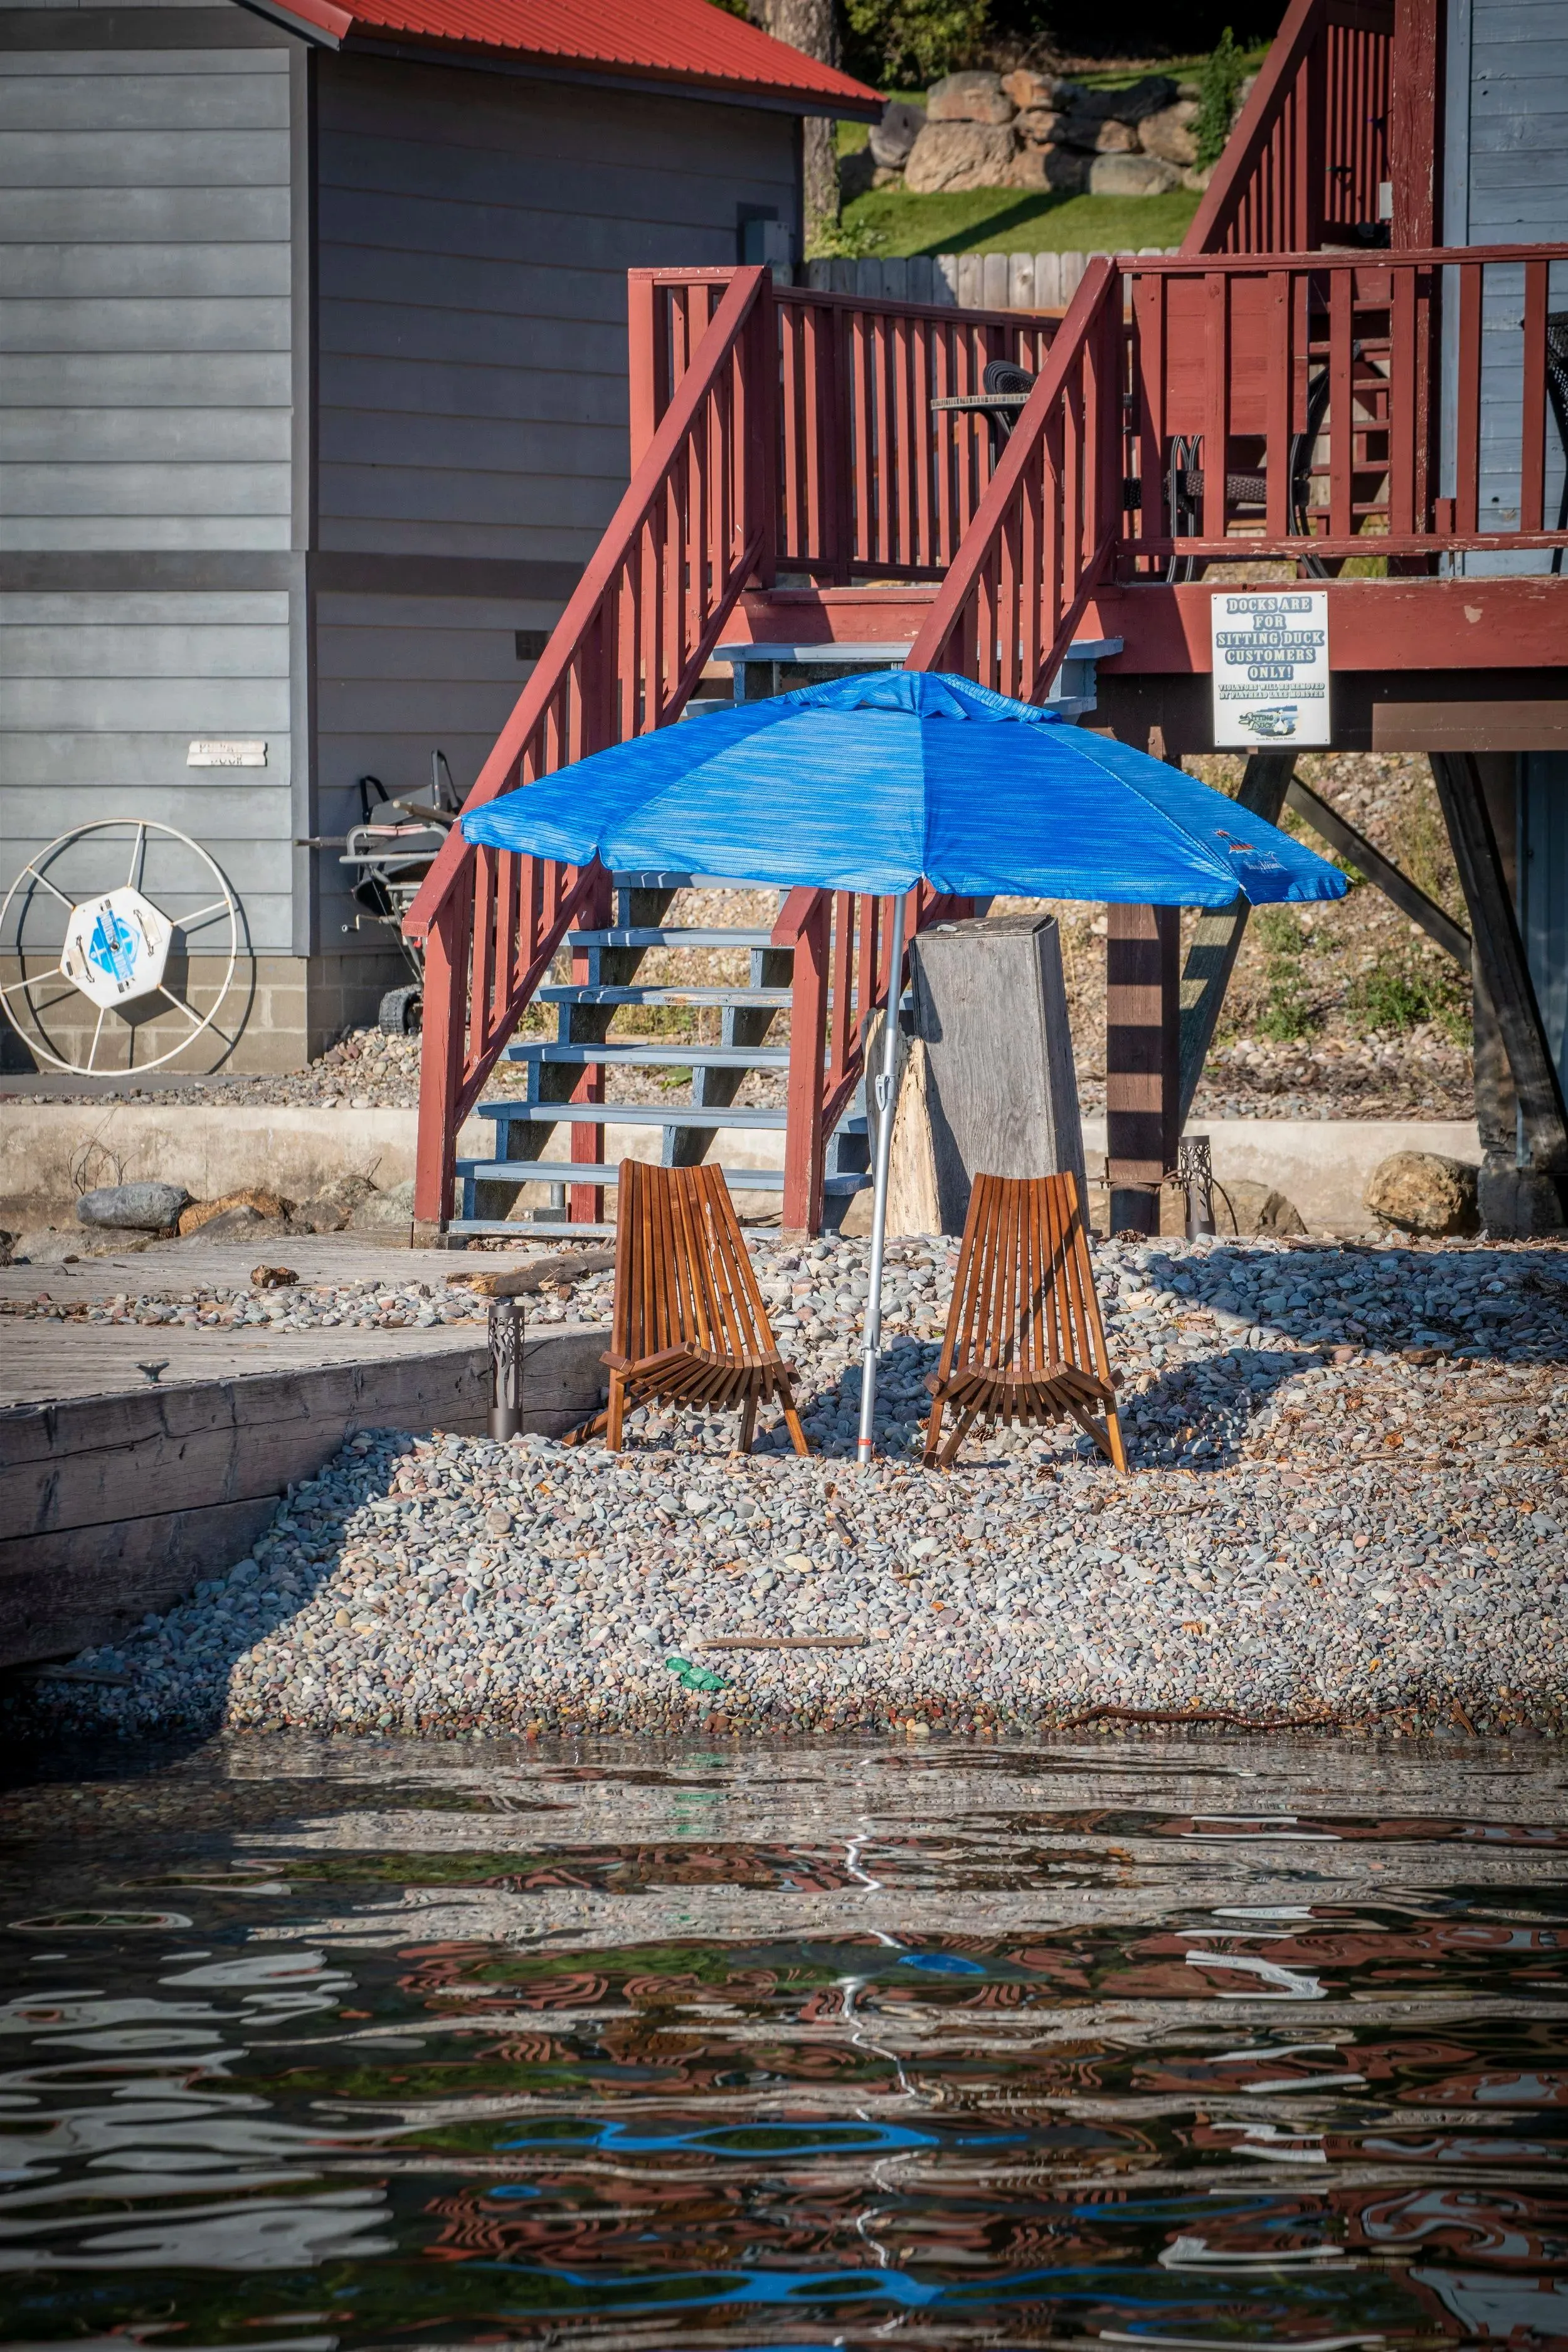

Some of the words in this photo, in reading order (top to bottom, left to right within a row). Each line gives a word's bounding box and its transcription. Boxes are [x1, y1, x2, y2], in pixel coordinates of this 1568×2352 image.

[1227, 598, 1276, 612] DOCKS
[1280, 598, 1310, 611] ARE
[1254, 615, 1285, 628] FOR
[1217, 632, 1279, 647] SITTING
[1283, 631, 1323, 645] DUCK
[1226, 649, 1315, 662] CUSTOMERS
[1249, 666, 1292, 679] ONLY!
[1290, 682, 1325, 691] REMOVED
